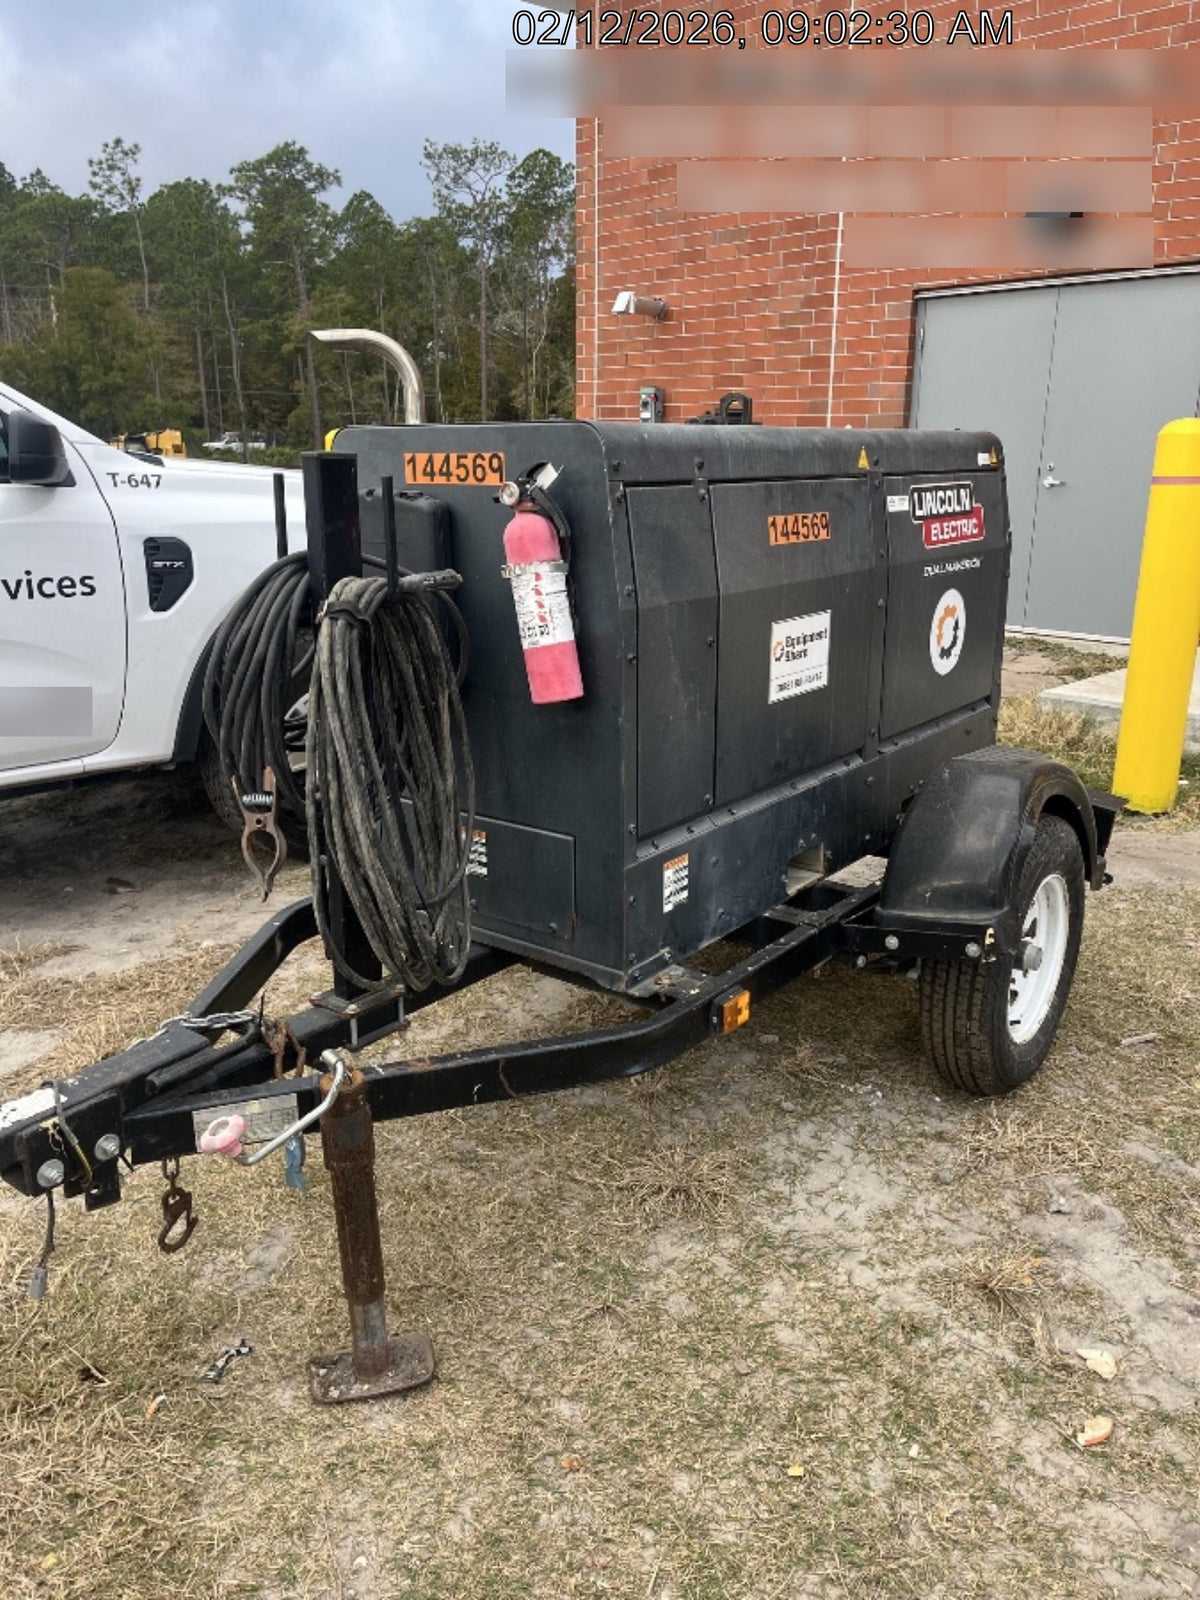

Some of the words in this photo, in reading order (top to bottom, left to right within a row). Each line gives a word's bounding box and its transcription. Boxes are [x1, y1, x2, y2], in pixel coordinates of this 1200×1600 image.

[106, 472, 162, 489] T-647
[405, 452, 504, 483] 144569
[913, 488, 972, 517] LINCOLN
[769, 513, 830, 542] 144569
[931, 518, 979, 542] ELECTRIC
